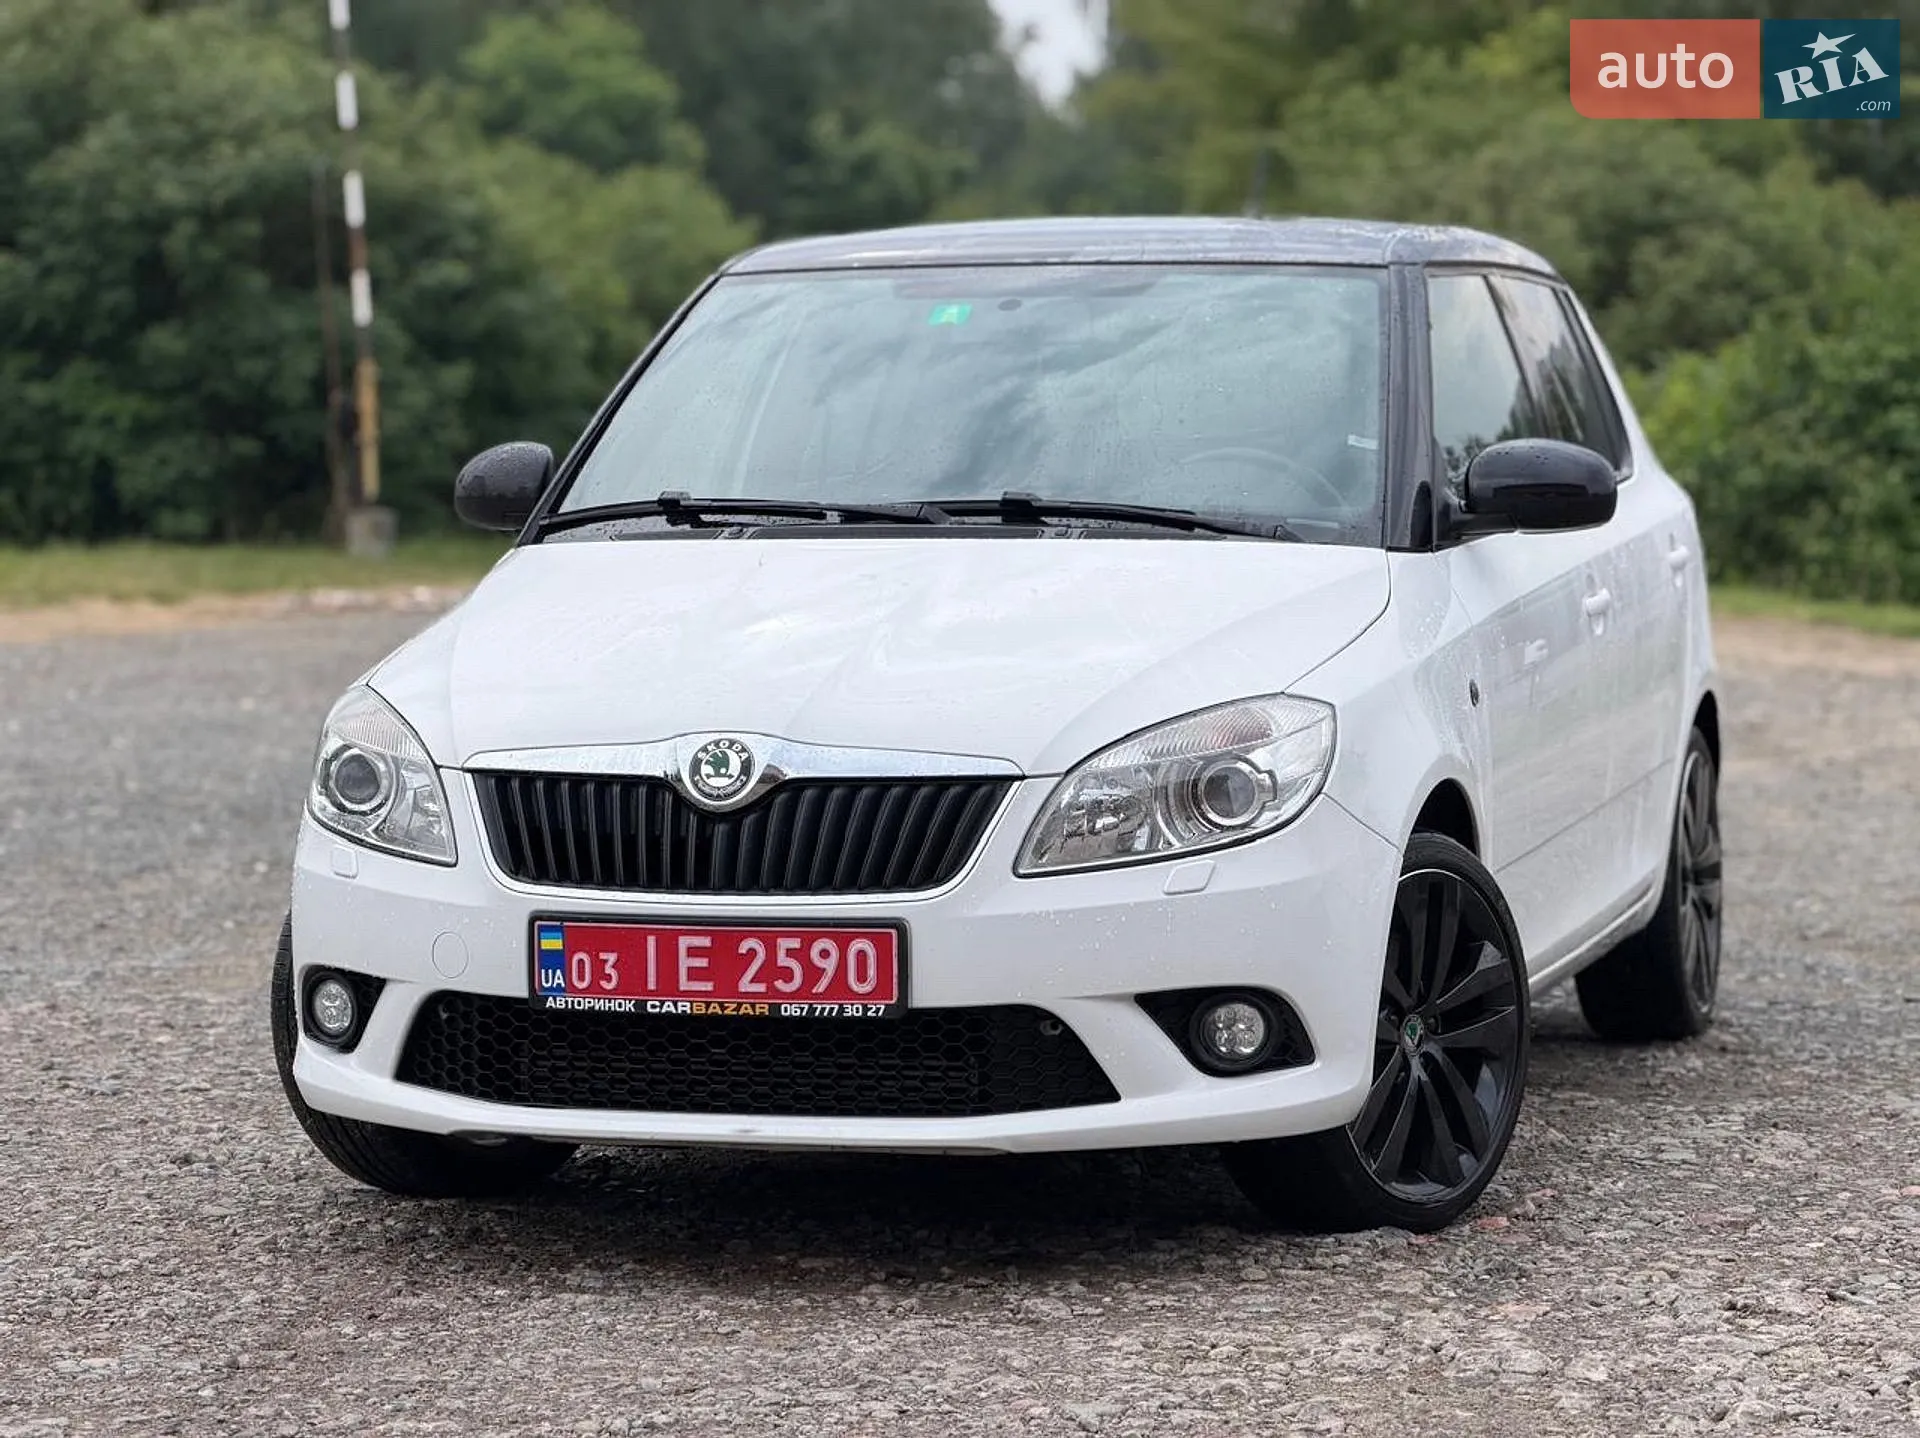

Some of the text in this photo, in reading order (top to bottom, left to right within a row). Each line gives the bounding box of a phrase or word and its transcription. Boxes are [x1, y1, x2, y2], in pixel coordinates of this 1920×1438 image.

[570, 951, 619, 990] 03
[737, 937, 878, 995] 2590
[541, 968, 565, 988] UA
[545, 996, 886, 1017] АВТОРИНОК CARBAZAR 067 777 30 27
